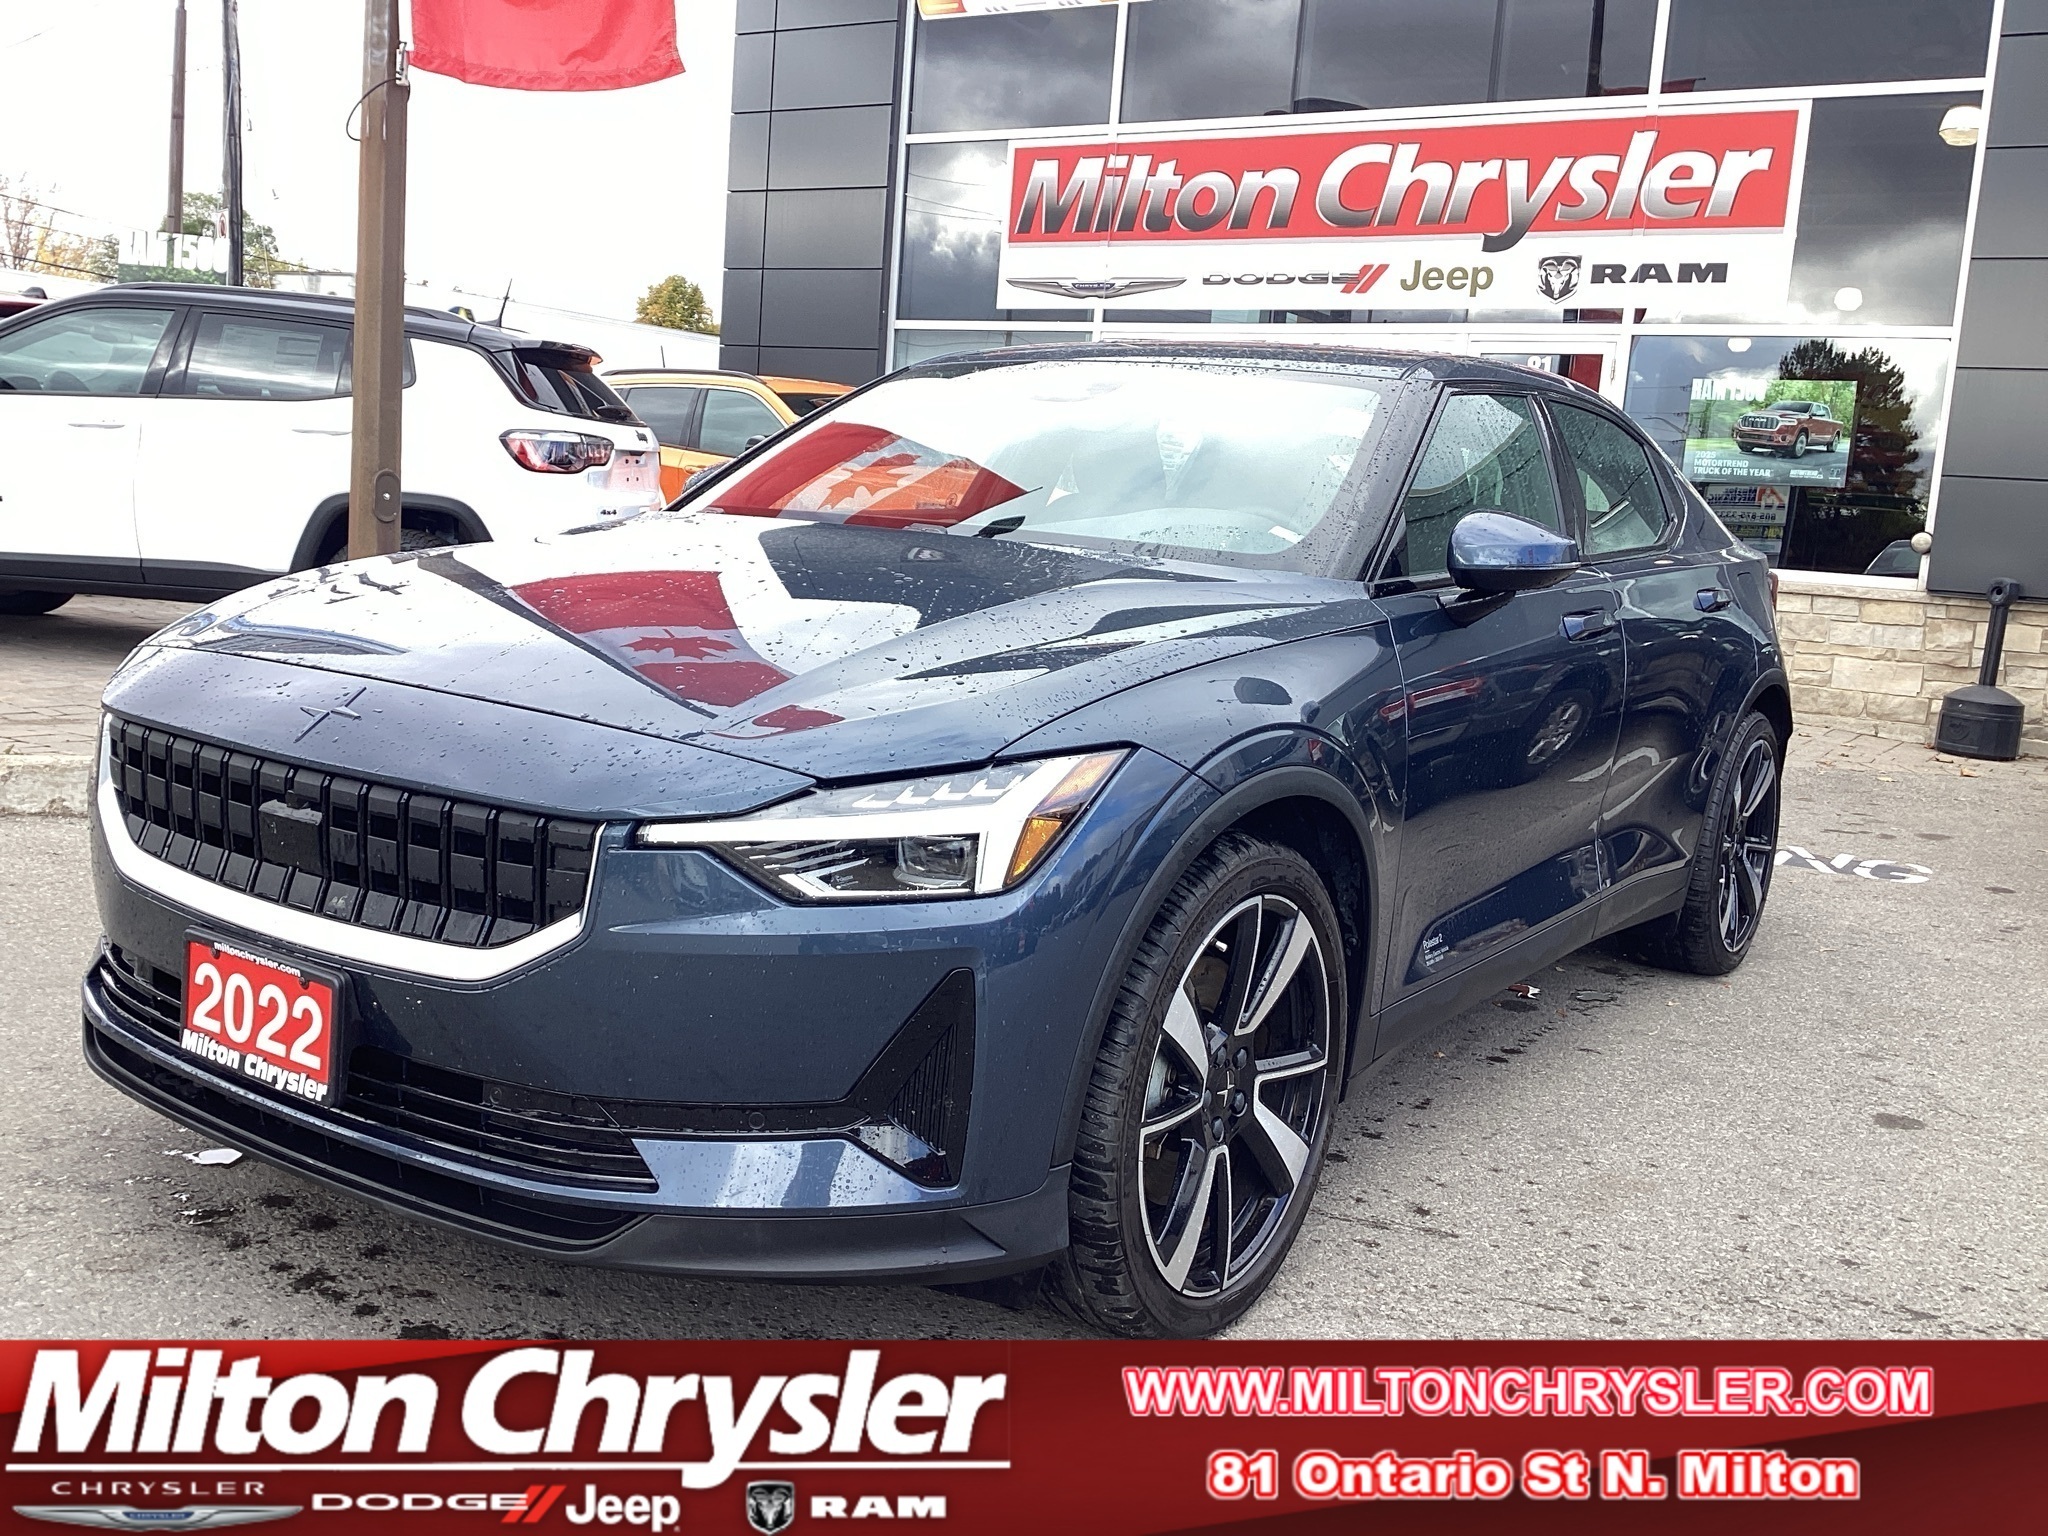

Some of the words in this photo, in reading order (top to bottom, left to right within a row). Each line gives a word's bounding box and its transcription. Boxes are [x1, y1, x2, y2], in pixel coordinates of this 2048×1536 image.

[1014, 153, 1300, 235] Milton
[1315, 130, 1774, 252] Chrysler
[1202, 270, 1361, 286] DODGE
[1400, 260, 1494, 297] Jeep
[1590, 262, 1728, 284] RAM
[1694, 458, 1749, 468] MOTORTREND
[1695, 451, 1717, 459] 2025
[1693, 466, 1720, 475] TRUCK
[1721, 467, 1733, 475] OF
[1733, 468, 1748, 476] THE
[1749, 469, 1771, 477] YEAR
[1439, 933, 1444, 943] 2
[213, 941, 301, 977] miltonchrysler.com
[192, 962, 323, 1071] 2022
[180, 1028, 240, 1070] Milton
[244, 1053, 328, 1102] Chrysler
